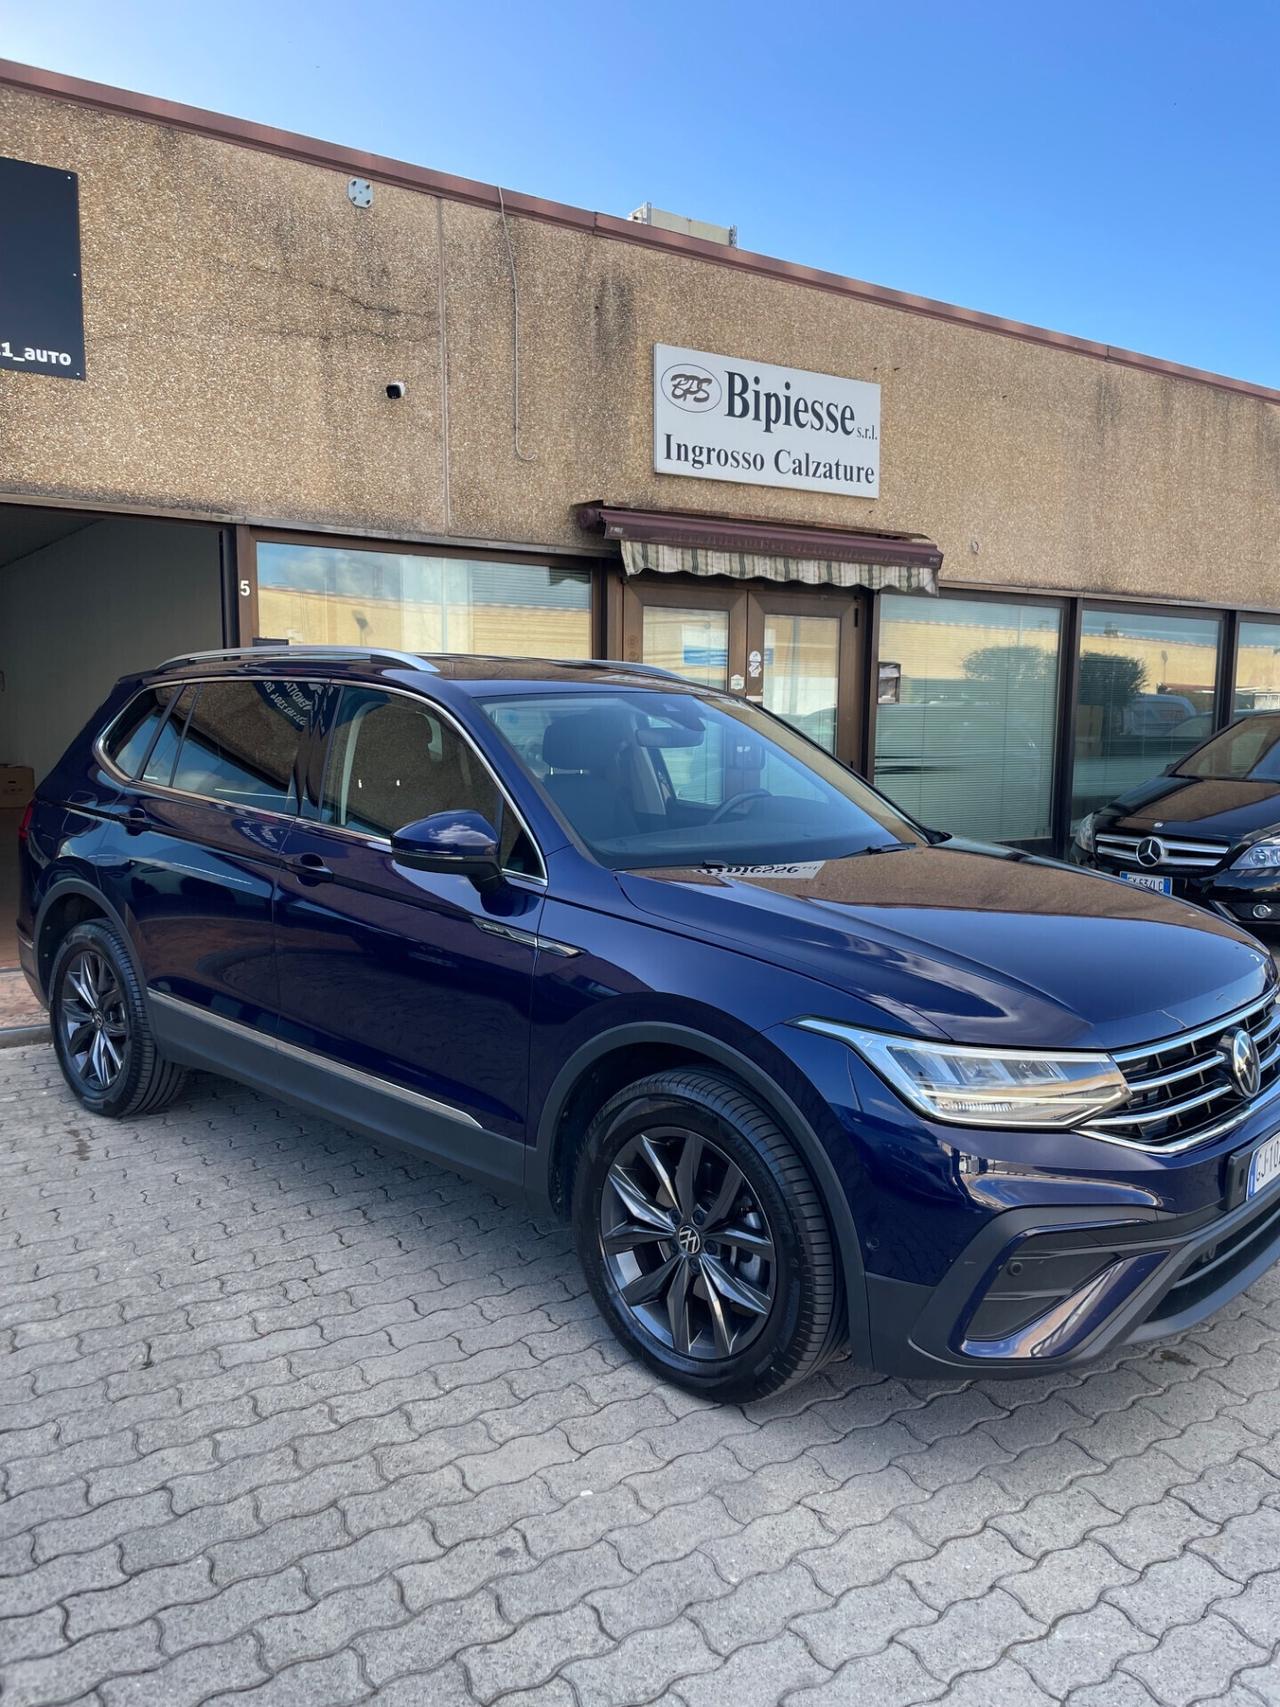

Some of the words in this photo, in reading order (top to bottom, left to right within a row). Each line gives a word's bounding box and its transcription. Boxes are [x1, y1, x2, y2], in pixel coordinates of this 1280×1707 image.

[724, 371, 855, 436] Bipiesse
[857, 424, 878, 441] s.r.l.
[664, 433, 765, 471] Ingrosso
[774, 449, 875, 484] Calzature
[240, 580, 251, 596] 5
